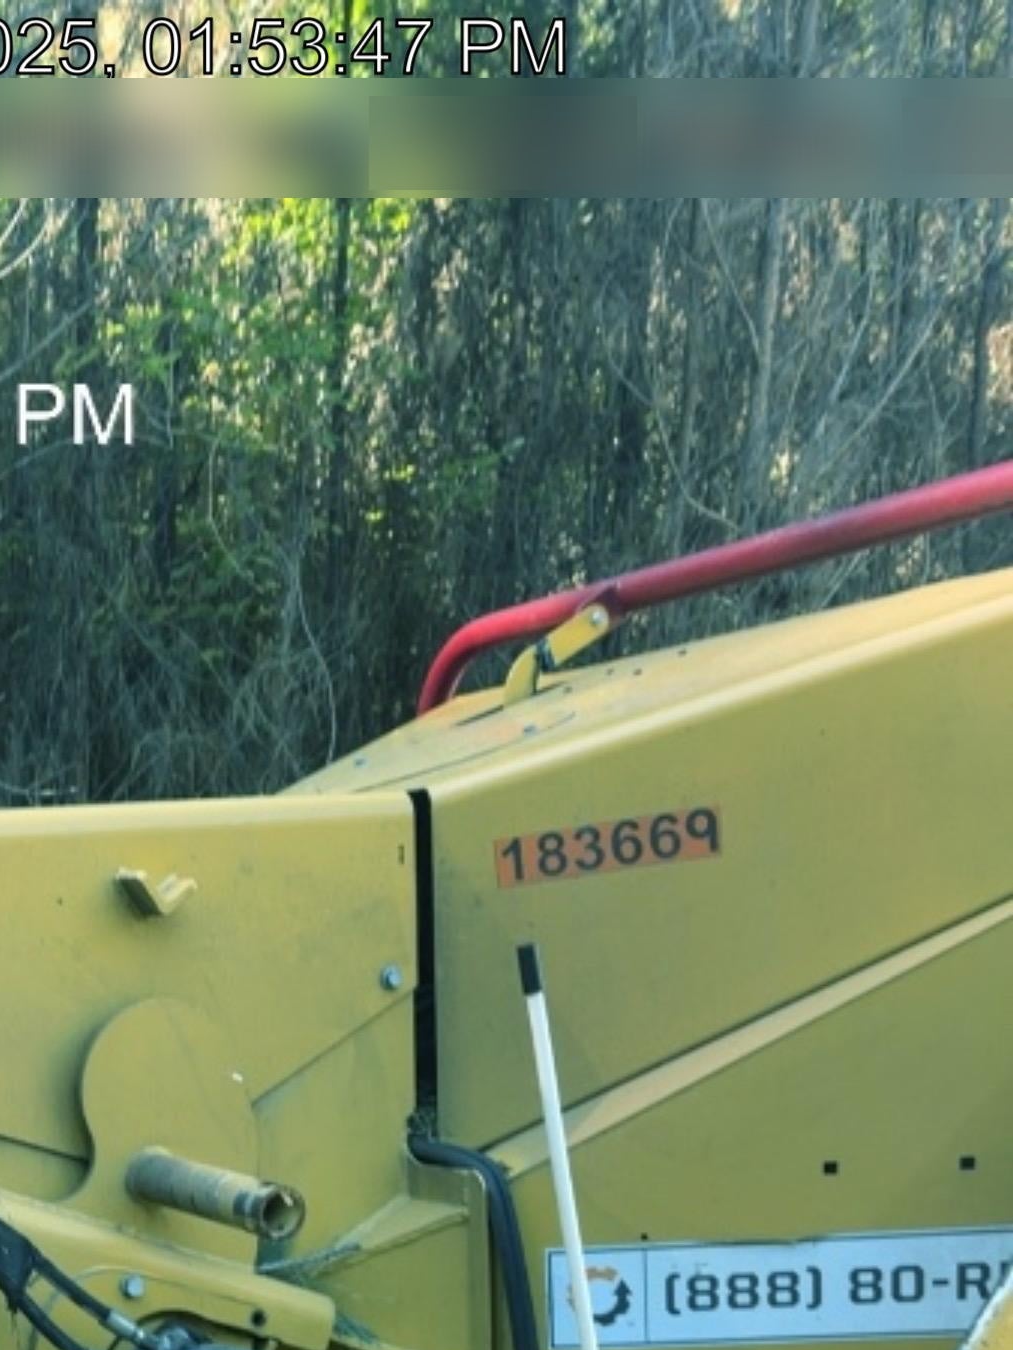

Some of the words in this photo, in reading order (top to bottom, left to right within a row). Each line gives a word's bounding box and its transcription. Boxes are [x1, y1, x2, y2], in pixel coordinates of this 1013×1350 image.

[501, 806, 720, 881] 183669
[664, 1265, 824, 1316] (888)
[848, 1260, 1013, 1305] 80-R
